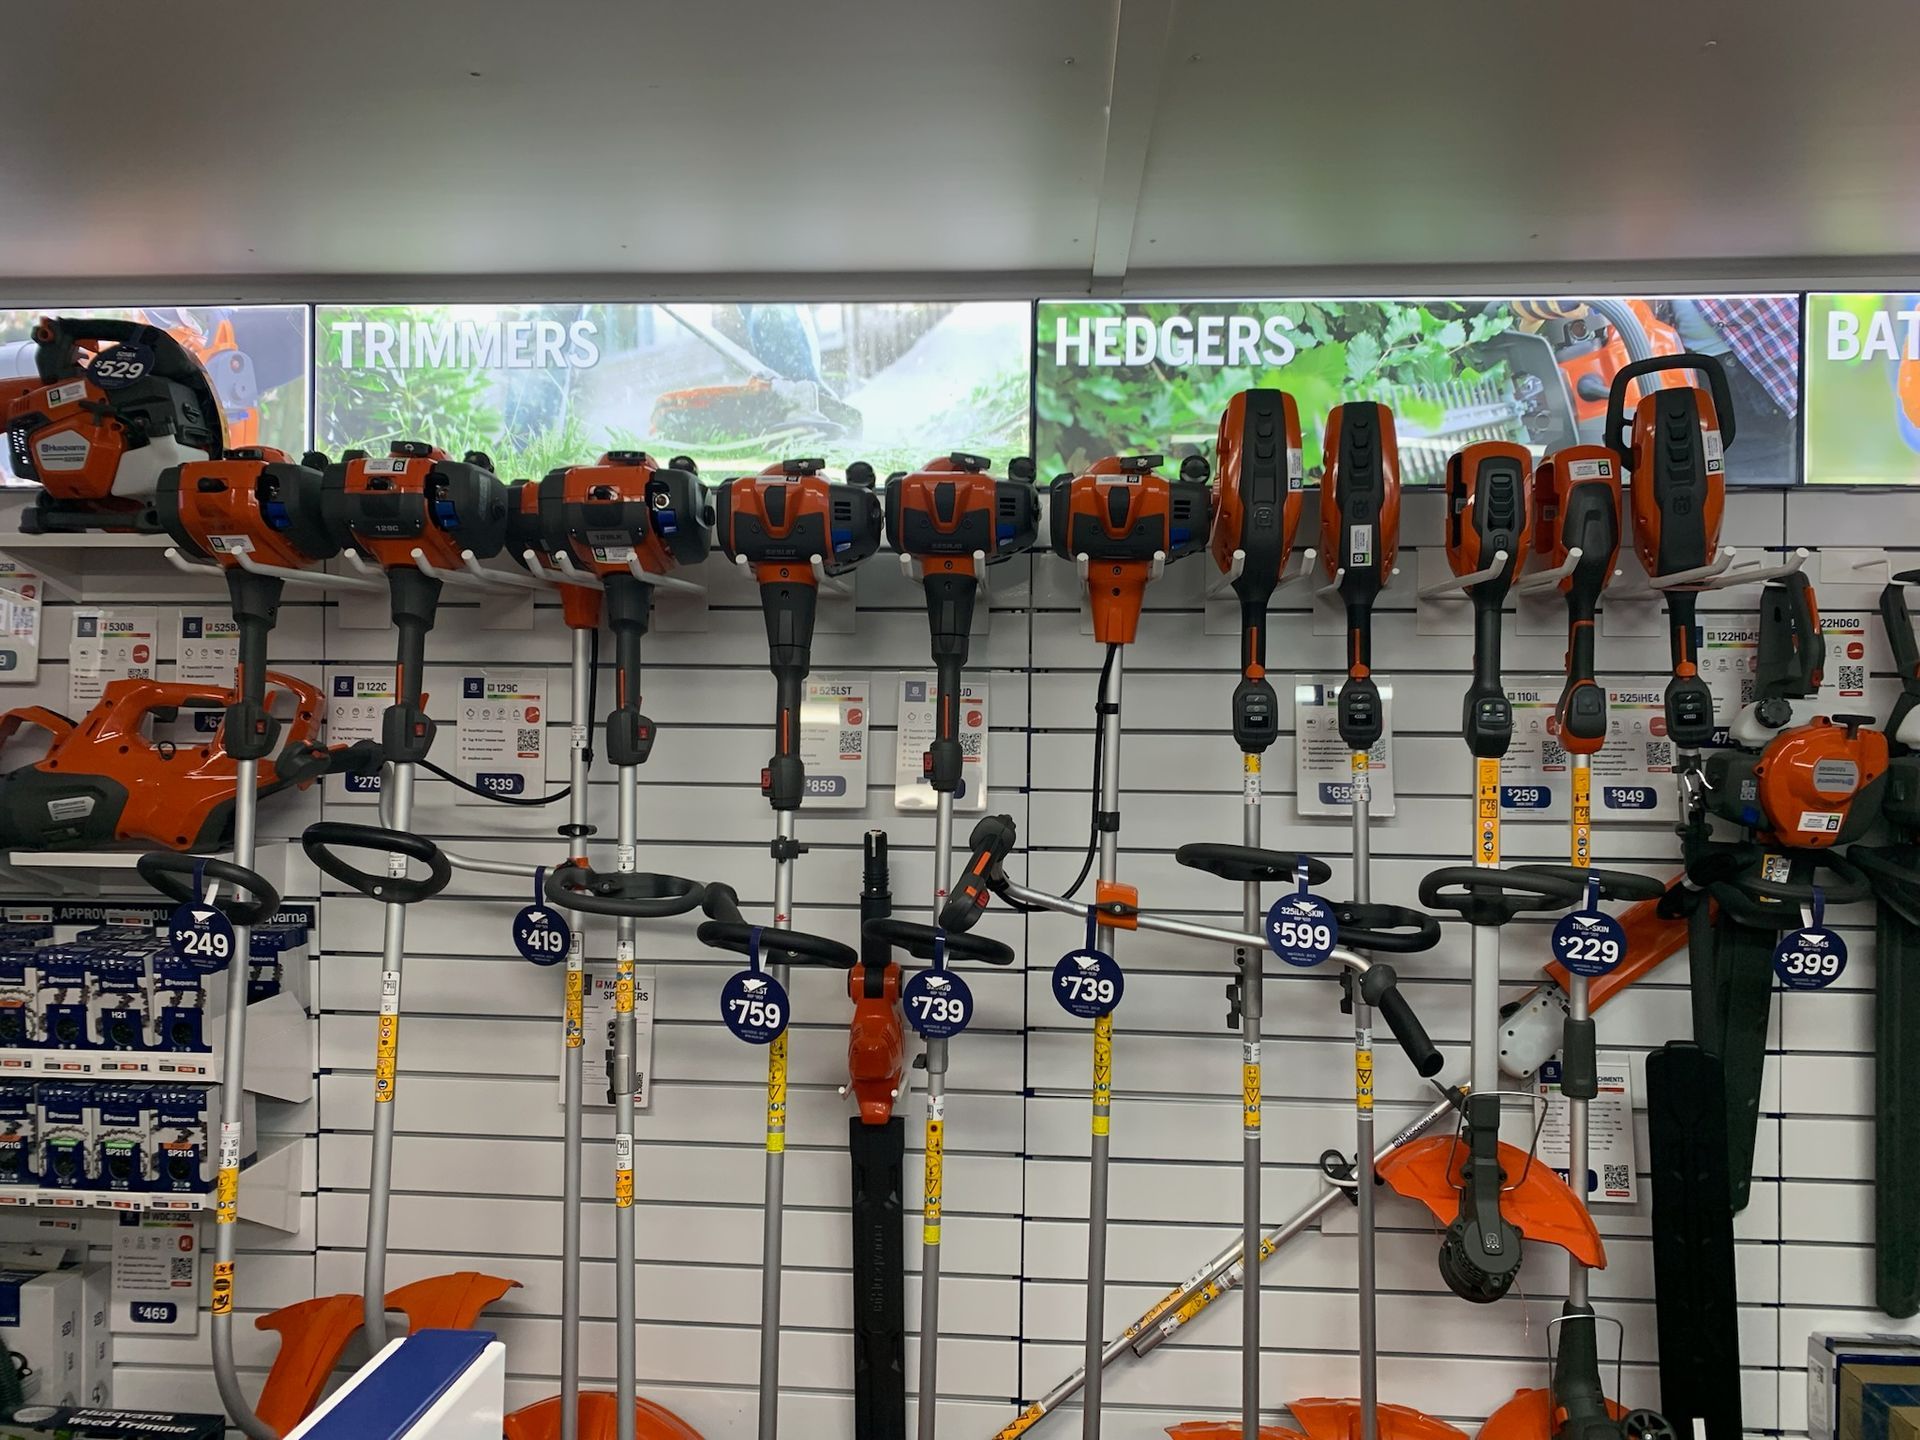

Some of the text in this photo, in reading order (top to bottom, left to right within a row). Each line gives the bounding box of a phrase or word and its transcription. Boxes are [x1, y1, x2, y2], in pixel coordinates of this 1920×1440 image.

[332, 320, 599, 369] TRIMMERS
[1056, 316, 1296, 367] HEDGERS
[95, 360, 144, 379] $529
[215, 624, 240, 632] 525B
[1820, 619, 1859, 628] 22HD60
[1717, 632, 1760, 641] 122HD45
[366, 683, 387, 691] 122C
[497, 684, 518, 692] 129C
[820, 686, 852, 695] 525LST
[1517, 692, 1540, 701] 110iL
[1620, 694, 1660, 702] 525iHE4
[354, 776, 381, 788] $279
[484, 778, 514, 791] $339
[807, 779, 836, 792] $859
[1508, 789, 1539, 802] $259
[1612, 789, 1645, 803] $949
[521, 929, 563, 952] $419
[1273, 922, 1331, 950] $599
[176, 930, 229, 958] $249
[1560, 936, 1619, 963] $229
[1781, 952, 1839, 976] $399
[1061, 976, 1114, 1003] $739
[729, 999, 781, 1029] $759
[912, 996, 964, 1023] $739
[138, 1306, 168, 1320] $469
[79, 1410, 175, 1422] Husqvarna
[67, 1418, 198, 1434] Weed Trimmer
